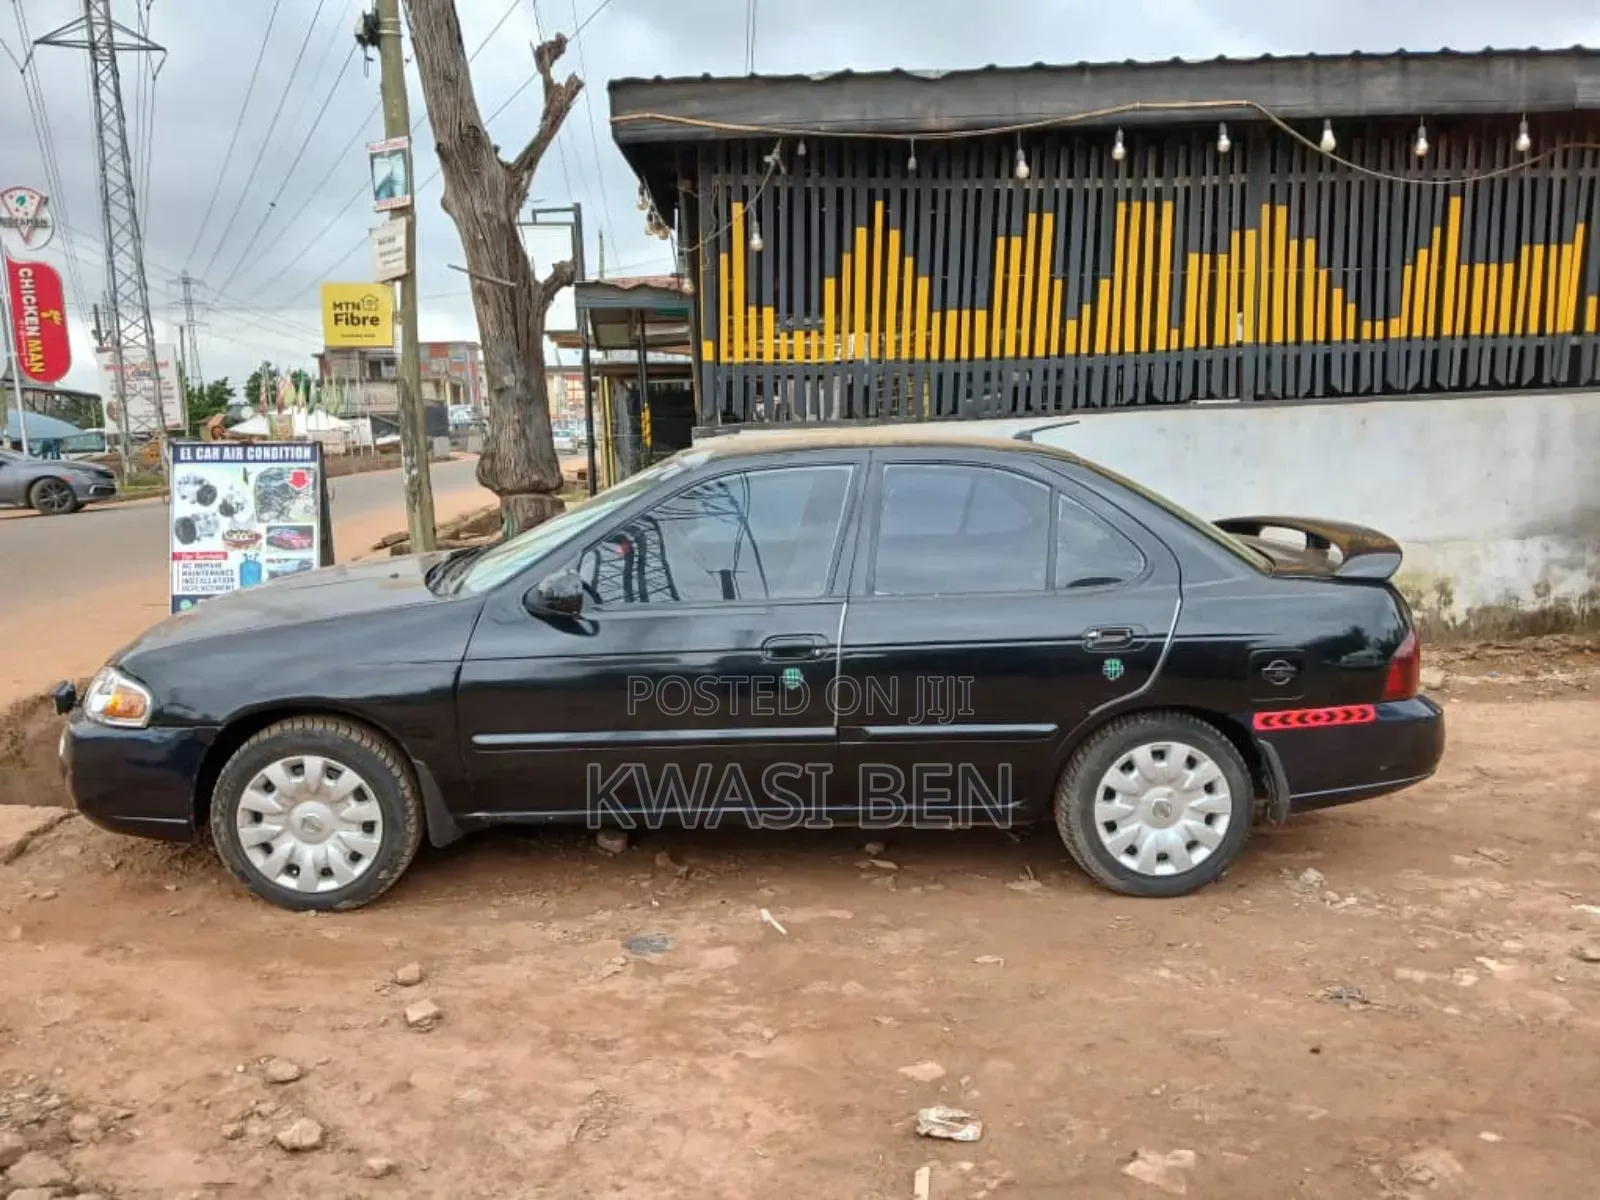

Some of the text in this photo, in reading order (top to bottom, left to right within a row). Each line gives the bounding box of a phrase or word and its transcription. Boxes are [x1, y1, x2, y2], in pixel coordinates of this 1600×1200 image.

[18, 267, 41, 337] CHICKEN
[332, 301, 361, 311] MTN
[334, 312, 380, 327] Fibre
[27, 339, 46, 373] MAN
[196, 447, 220, 460] CAR
[223, 447, 244, 460] AIR
[247, 446, 311, 460] CONDITION
